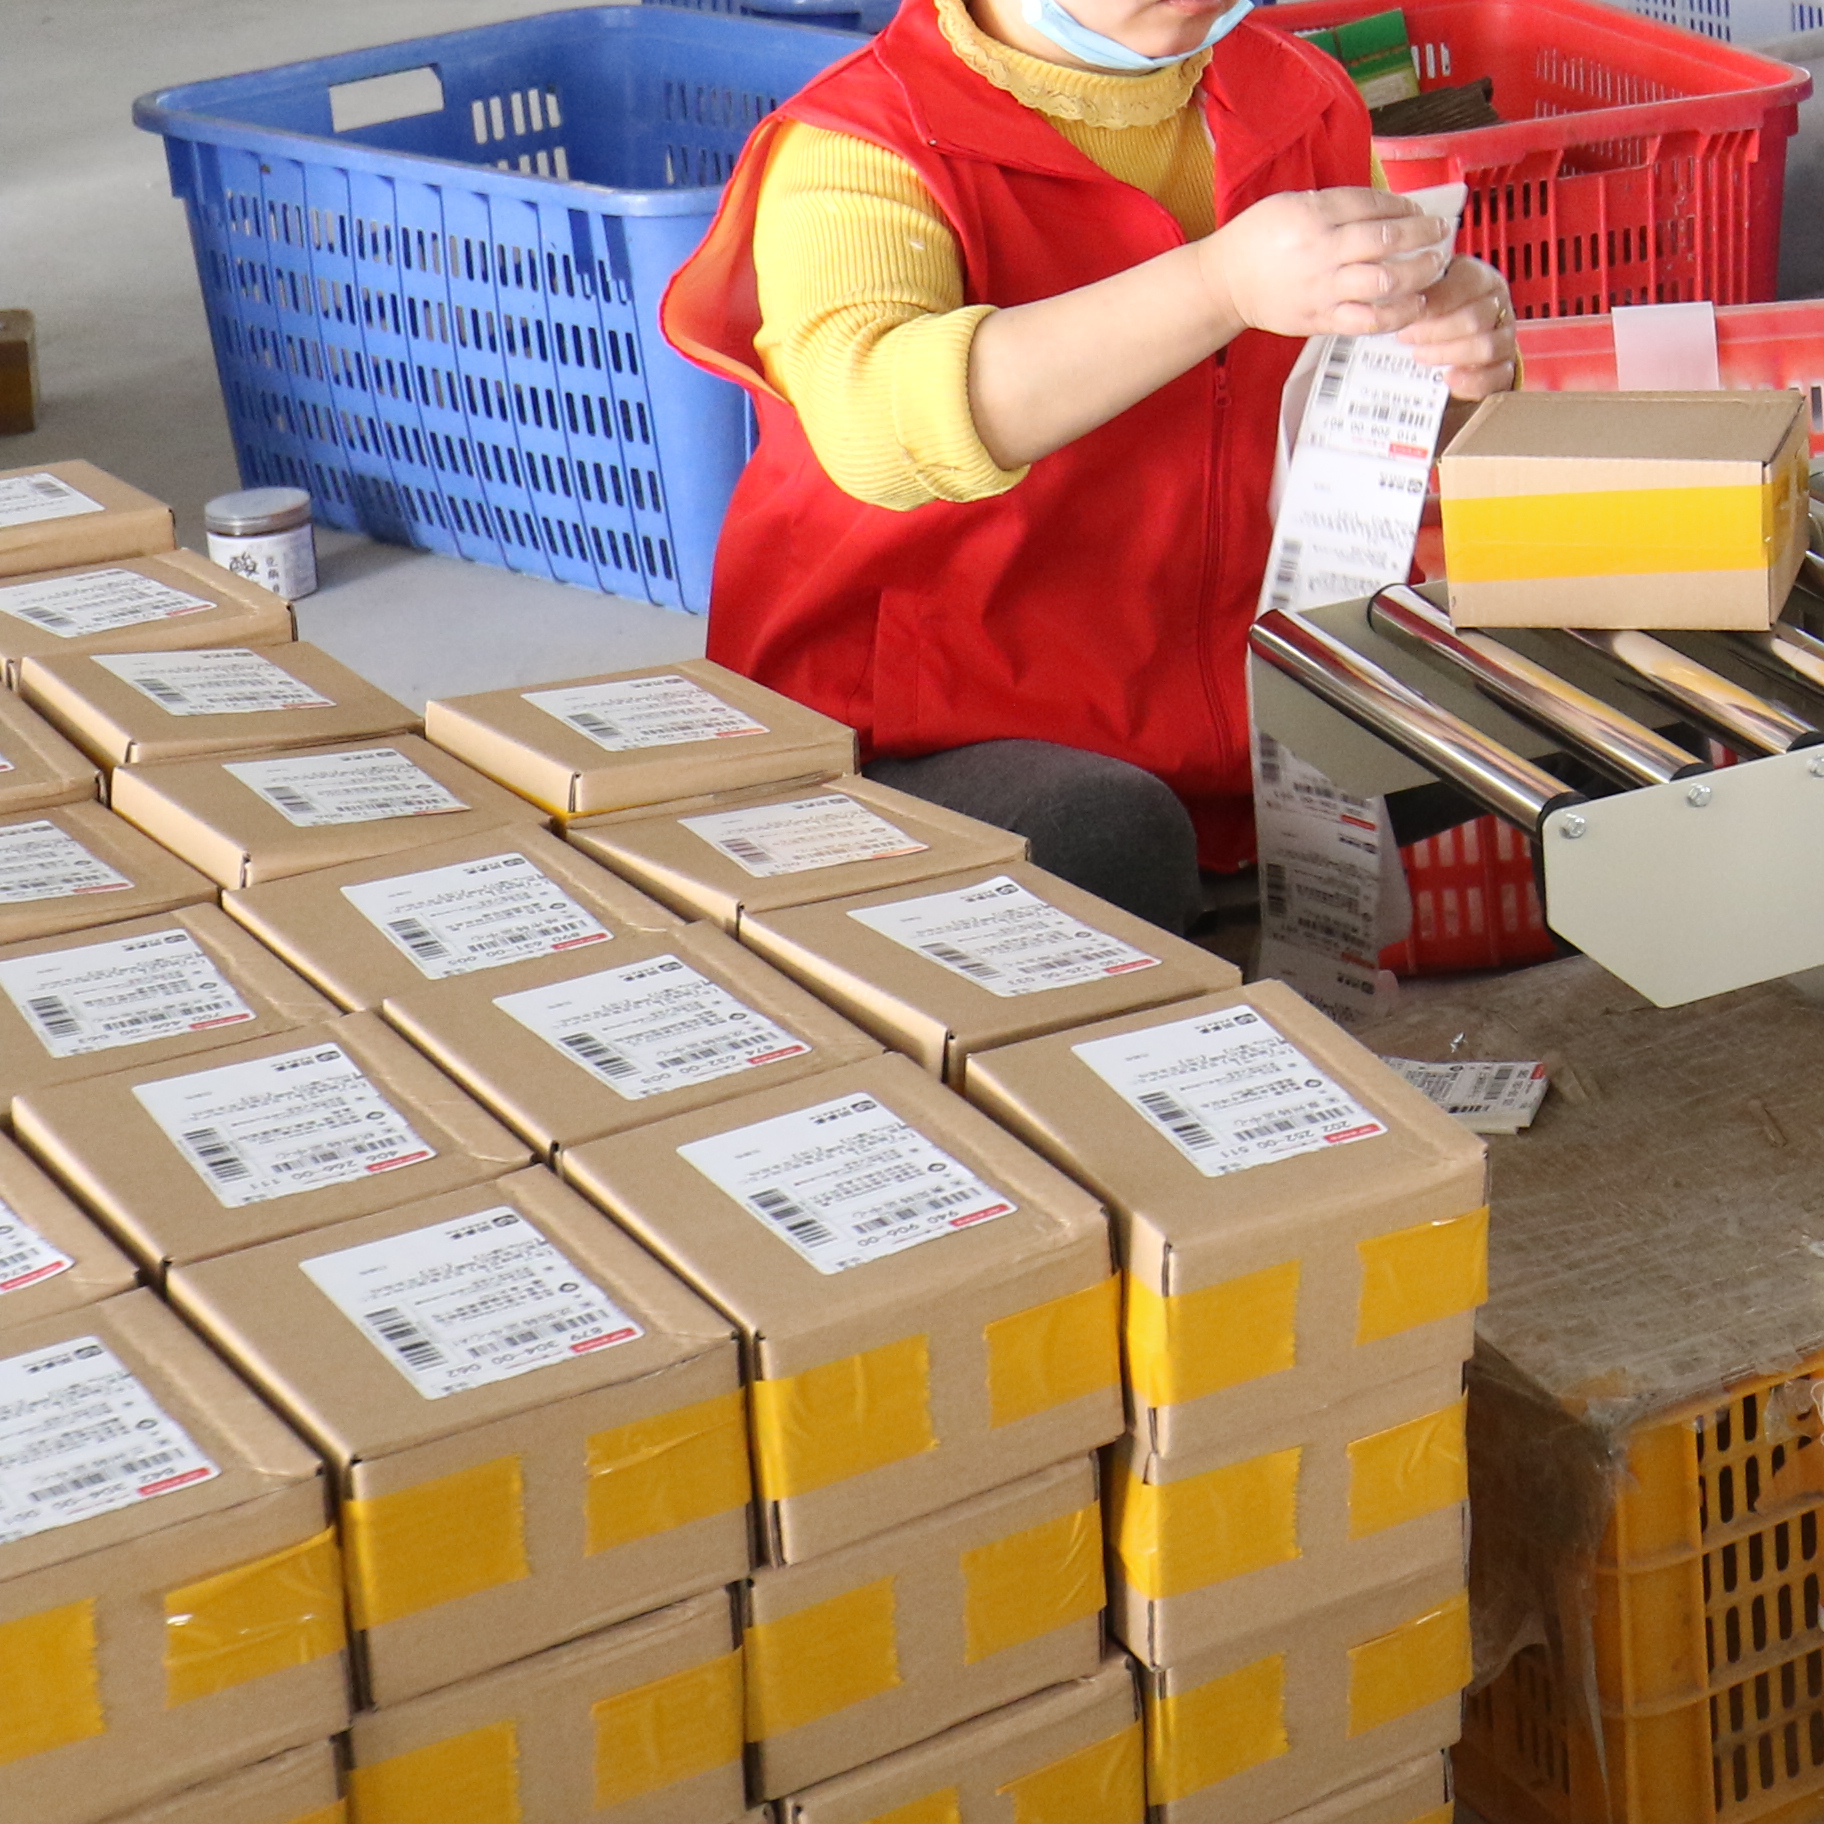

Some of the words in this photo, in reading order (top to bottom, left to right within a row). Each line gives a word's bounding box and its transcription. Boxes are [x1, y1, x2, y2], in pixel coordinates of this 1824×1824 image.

[1254, 1128, 1315, 1150] 252-00
[1218, 1144, 1251, 1159] 511
[923, 1208, 961, 1224] 940
[854, 1221, 921, 1248] 906-00
